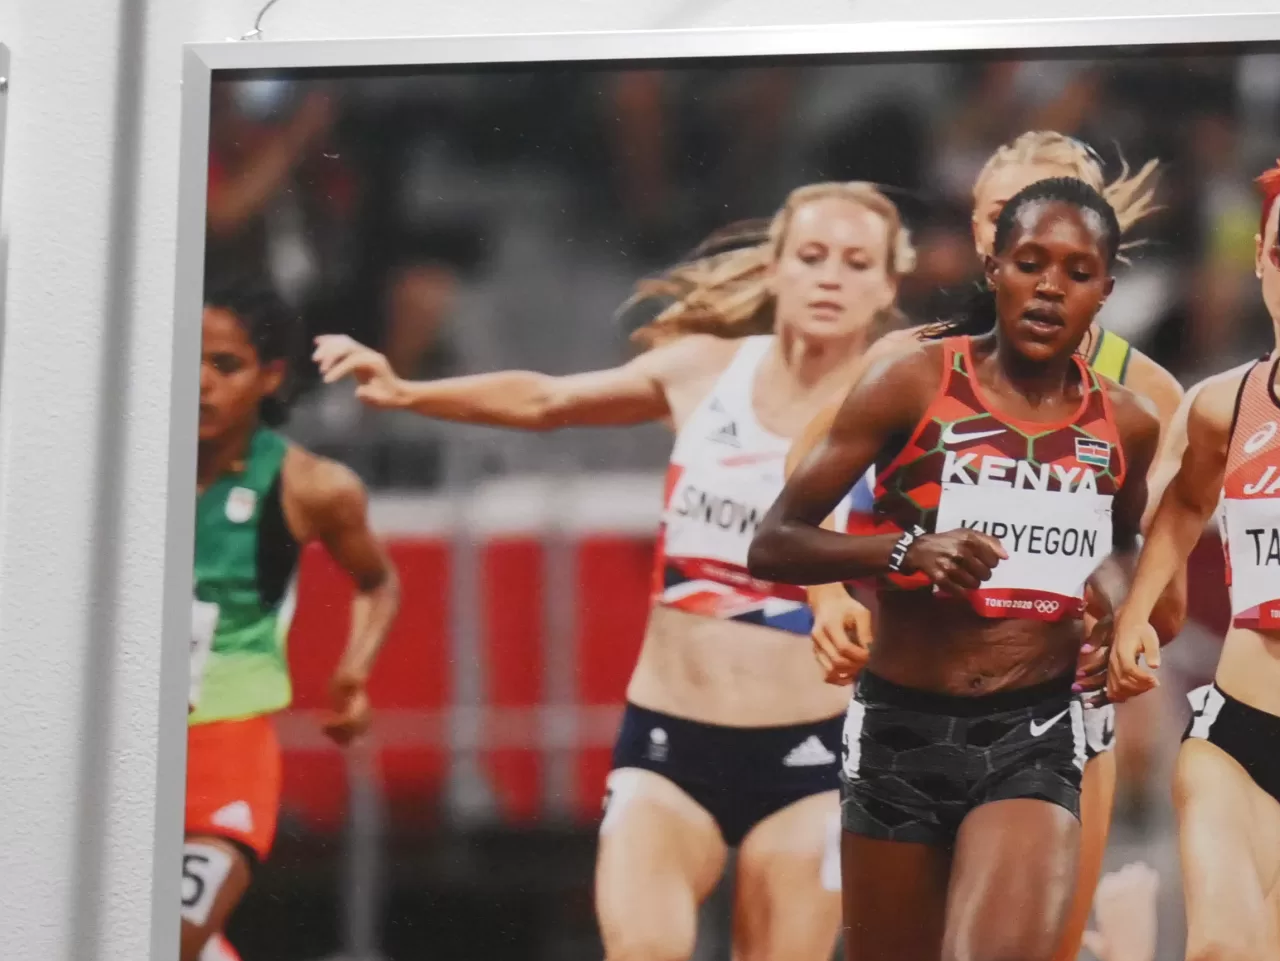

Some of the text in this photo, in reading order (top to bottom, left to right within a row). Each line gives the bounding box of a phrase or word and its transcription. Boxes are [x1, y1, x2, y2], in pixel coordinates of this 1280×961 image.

[941, 450, 1098, 494] KENYA
[984, 597, 1033, 610] TOKYO 2020
